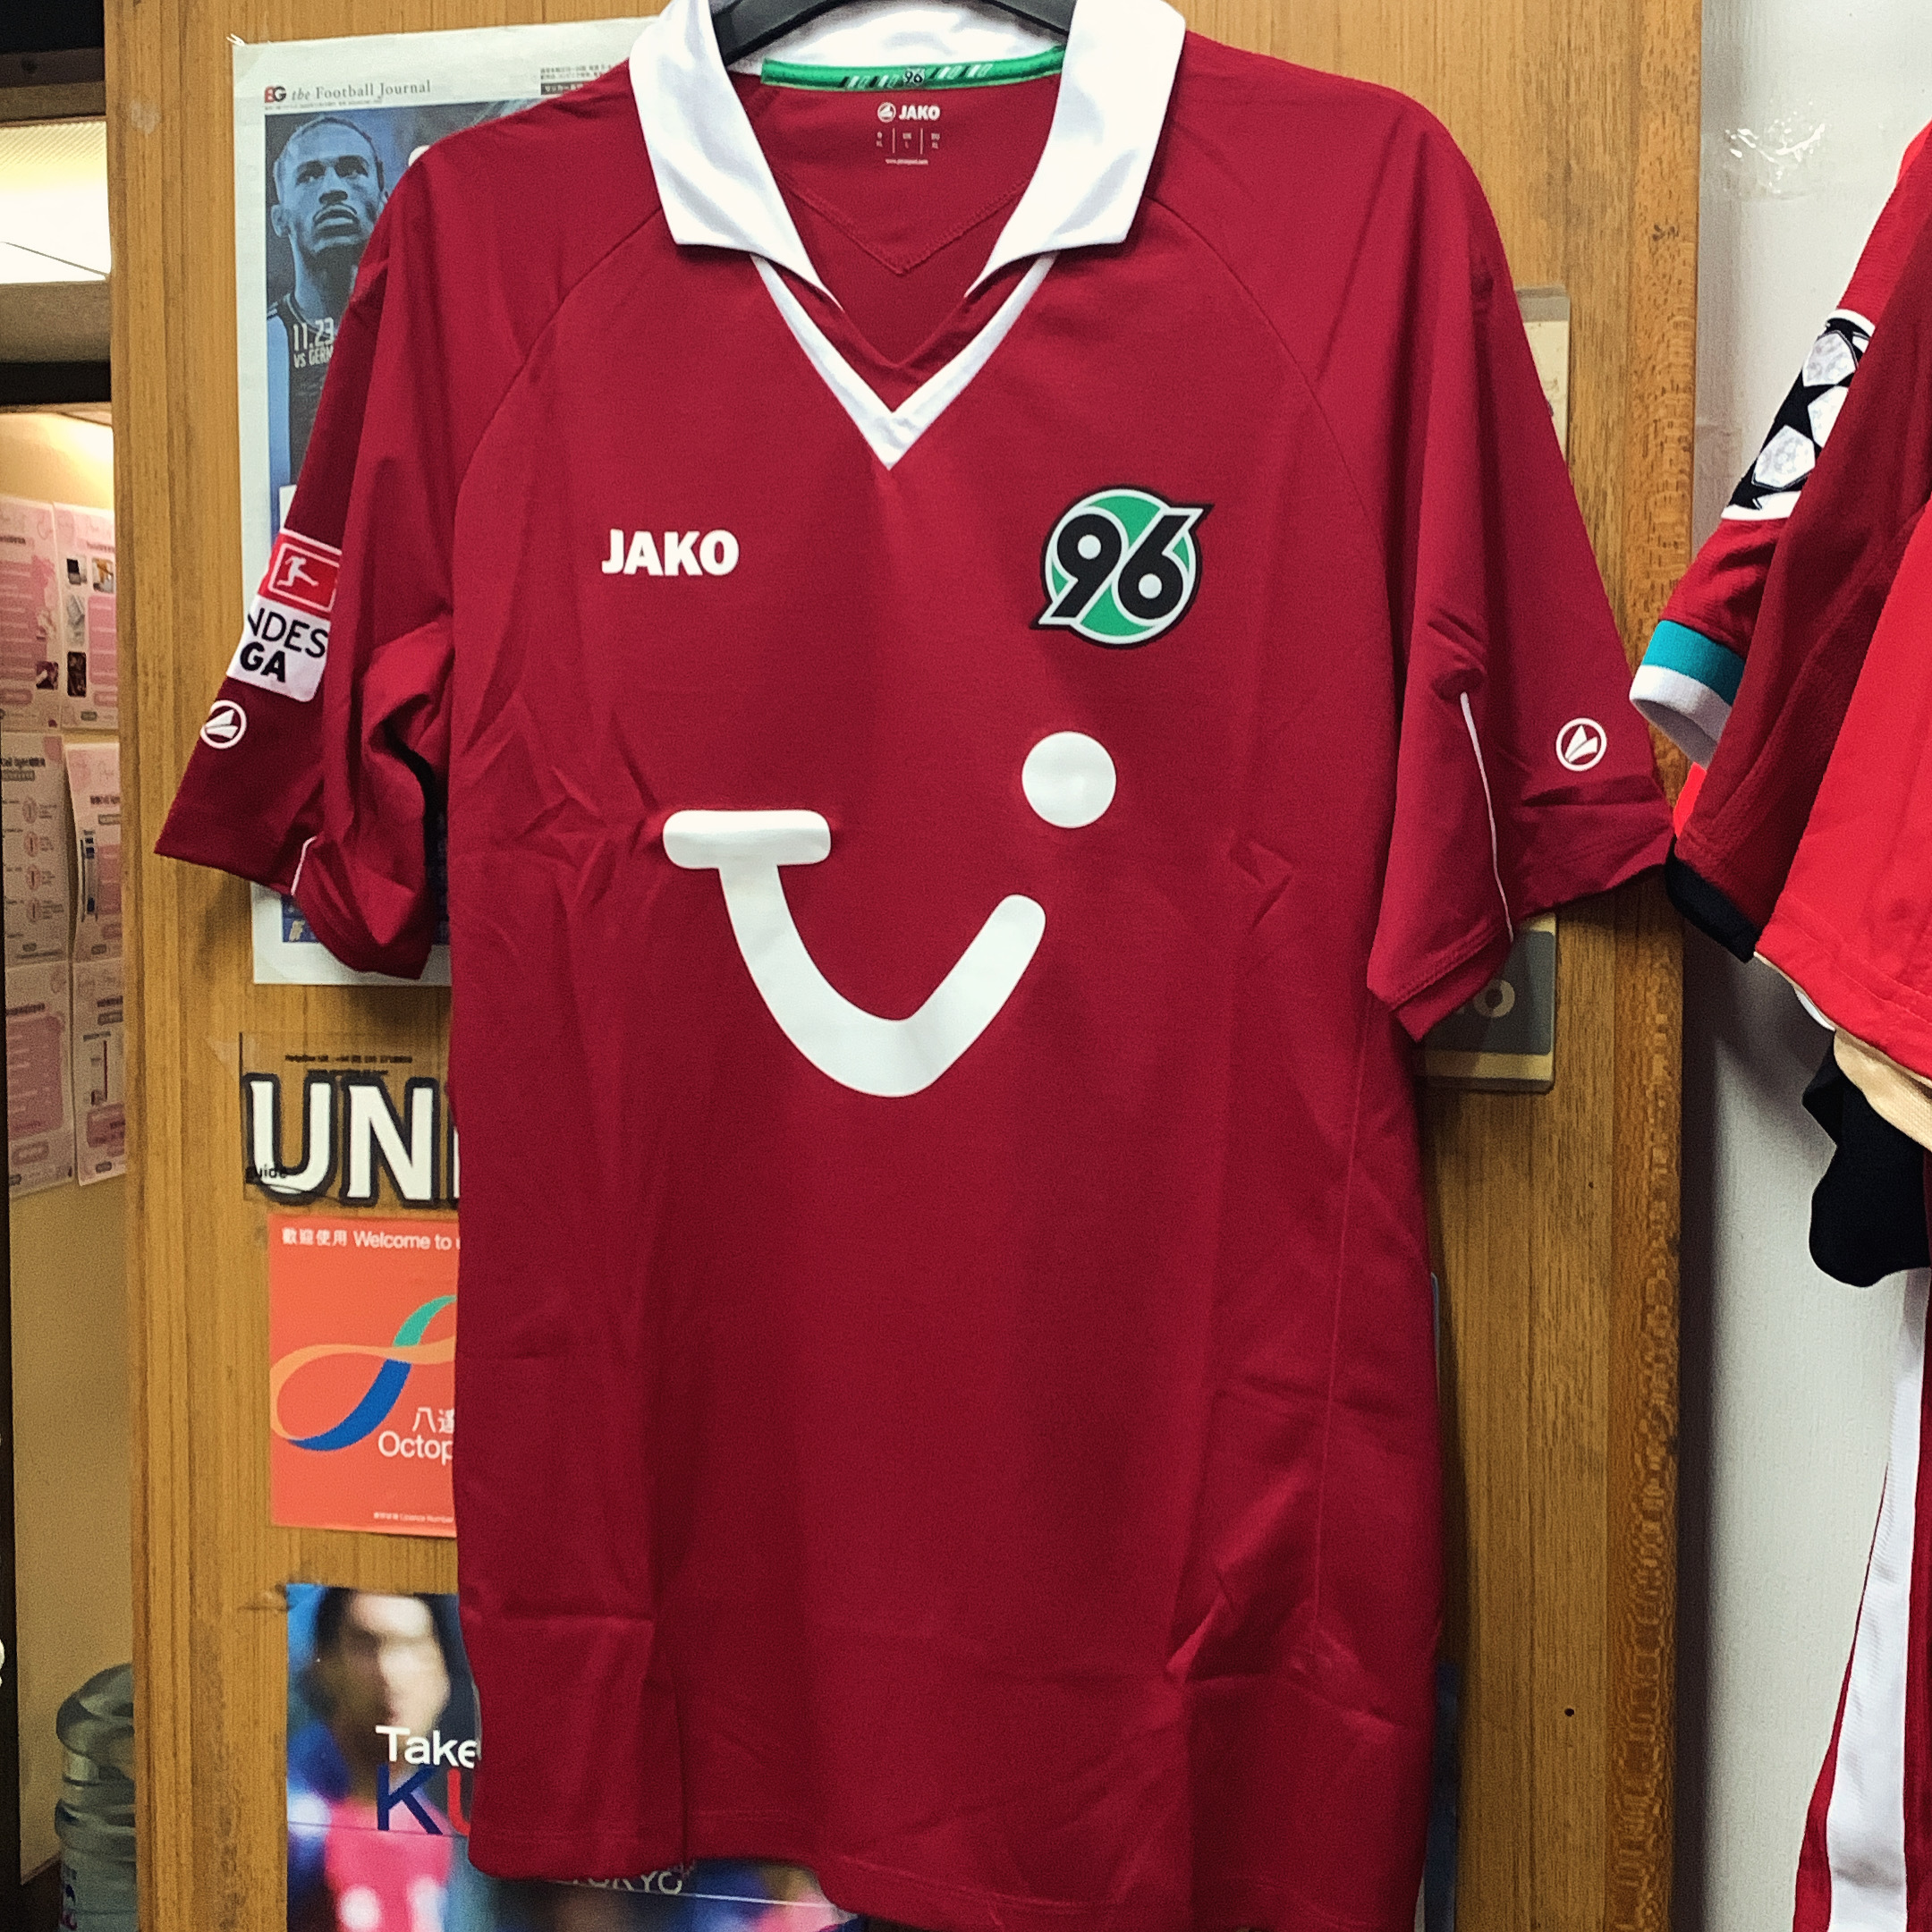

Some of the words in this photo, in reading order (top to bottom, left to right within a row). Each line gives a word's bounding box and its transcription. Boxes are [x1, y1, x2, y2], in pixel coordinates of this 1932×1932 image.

[292, 87, 310, 101] the
[316, 82, 374, 100] Football
[377, 80, 431, 99] Journal
[899, 105, 940, 121] JAKO
[293, 317, 334, 352] 11.23
[602, 529, 740, 576] JAKO
[1040, 503, 1205, 629] 96
[243, 1072, 460, 1208] UN
[353, 1230, 431, 1250] Welcome
[434, 1233, 452, 1250] to
[375, 1724, 478, 1768] Take
